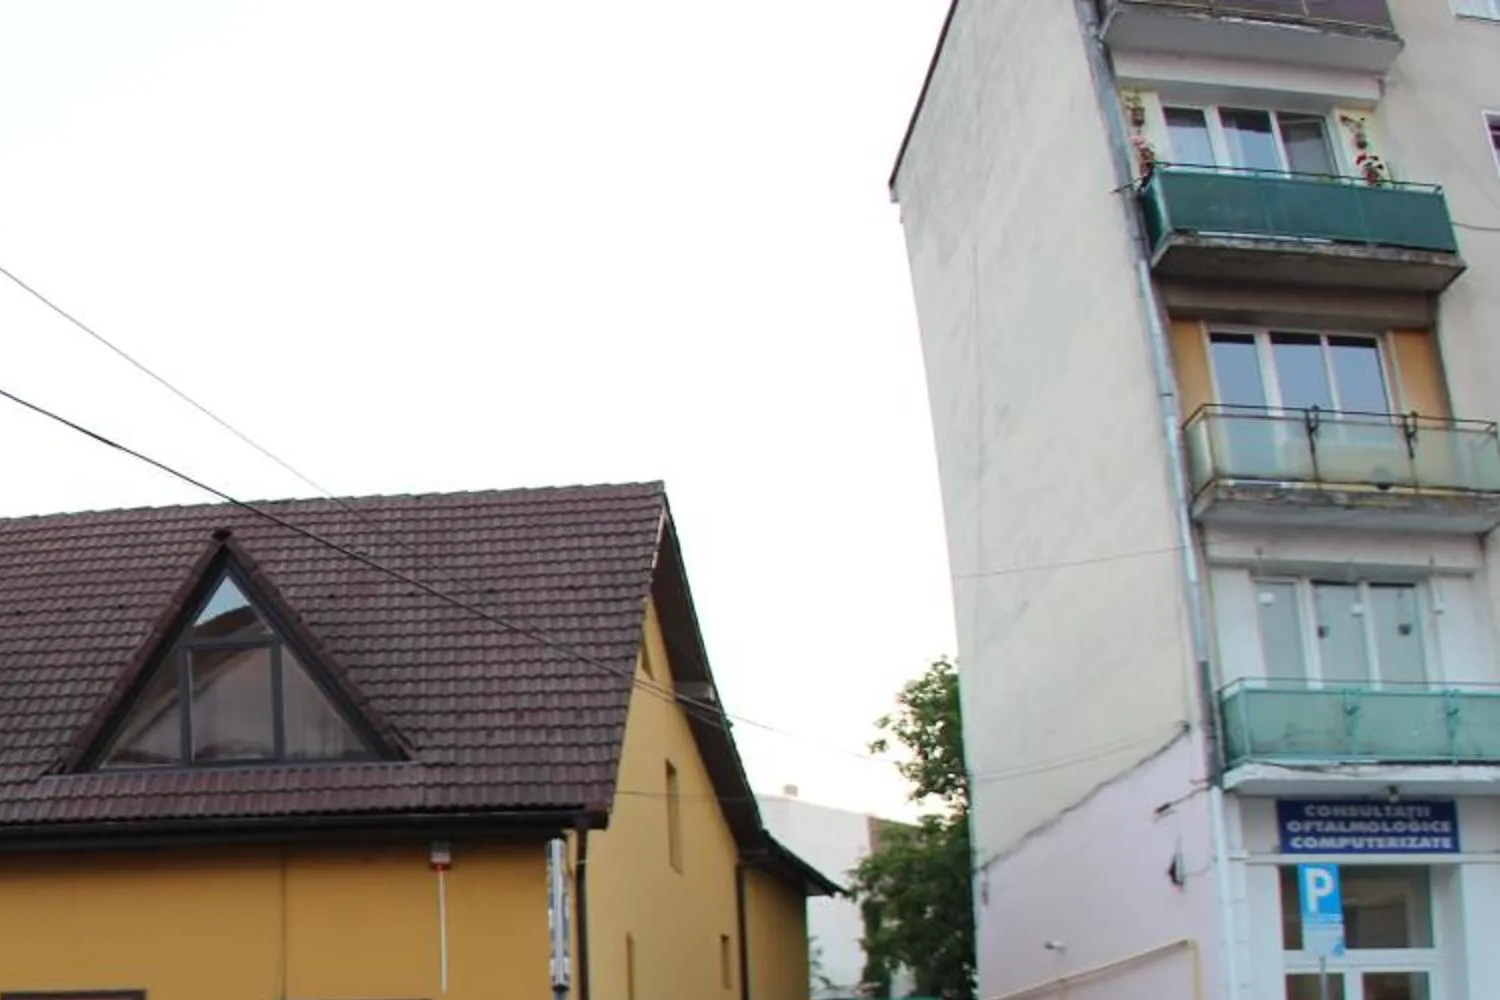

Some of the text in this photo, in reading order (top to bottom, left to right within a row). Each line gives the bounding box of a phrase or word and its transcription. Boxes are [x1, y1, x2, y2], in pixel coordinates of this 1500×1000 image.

[1287, 820, 1452, 833] OFTALMOLOGICE
[1290, 837, 1452, 849] COMPUTERIZATE
[1304, 867, 1333, 913] P
